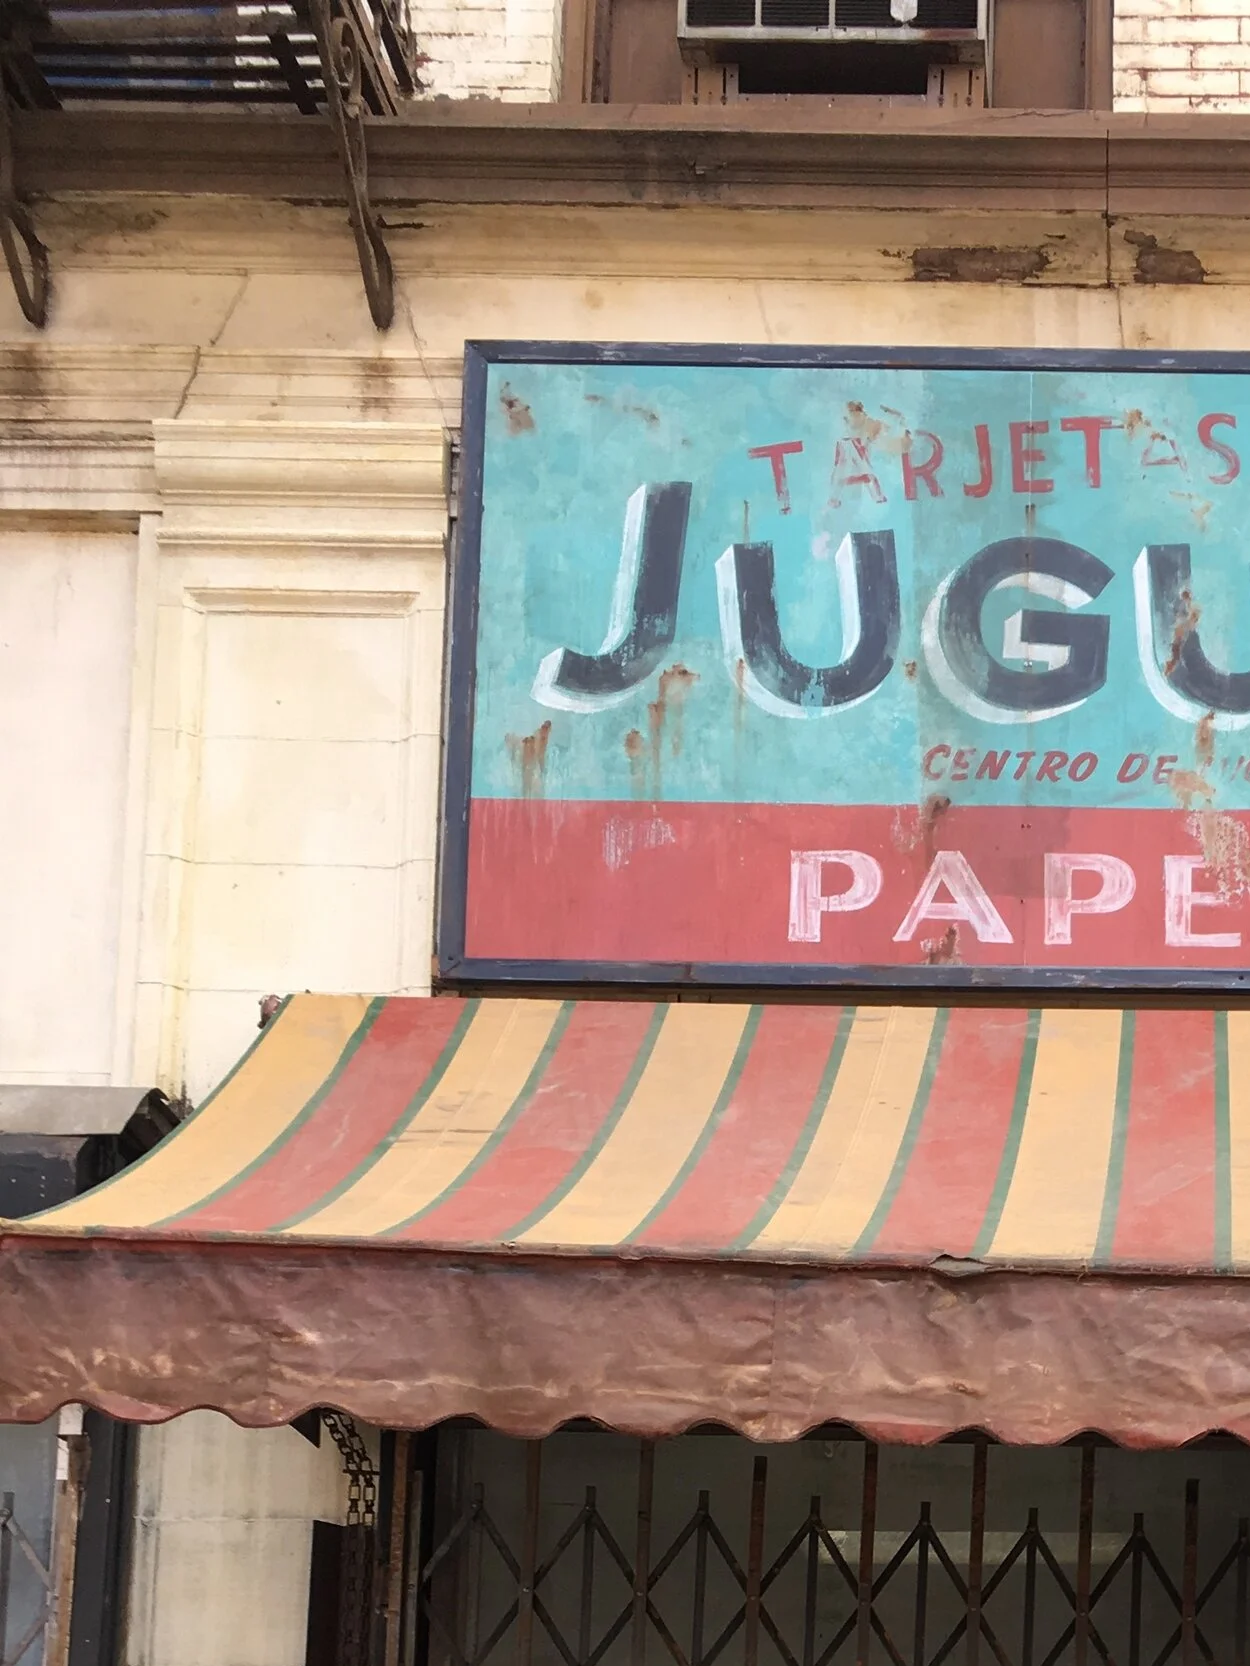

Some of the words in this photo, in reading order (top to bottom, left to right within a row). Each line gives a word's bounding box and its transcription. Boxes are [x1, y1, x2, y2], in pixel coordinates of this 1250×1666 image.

[748, 412, 1241, 515] TARJETAS
[922, 743, 1099, 783] CENTRO
[1116, 752, 1179, 785] DE
